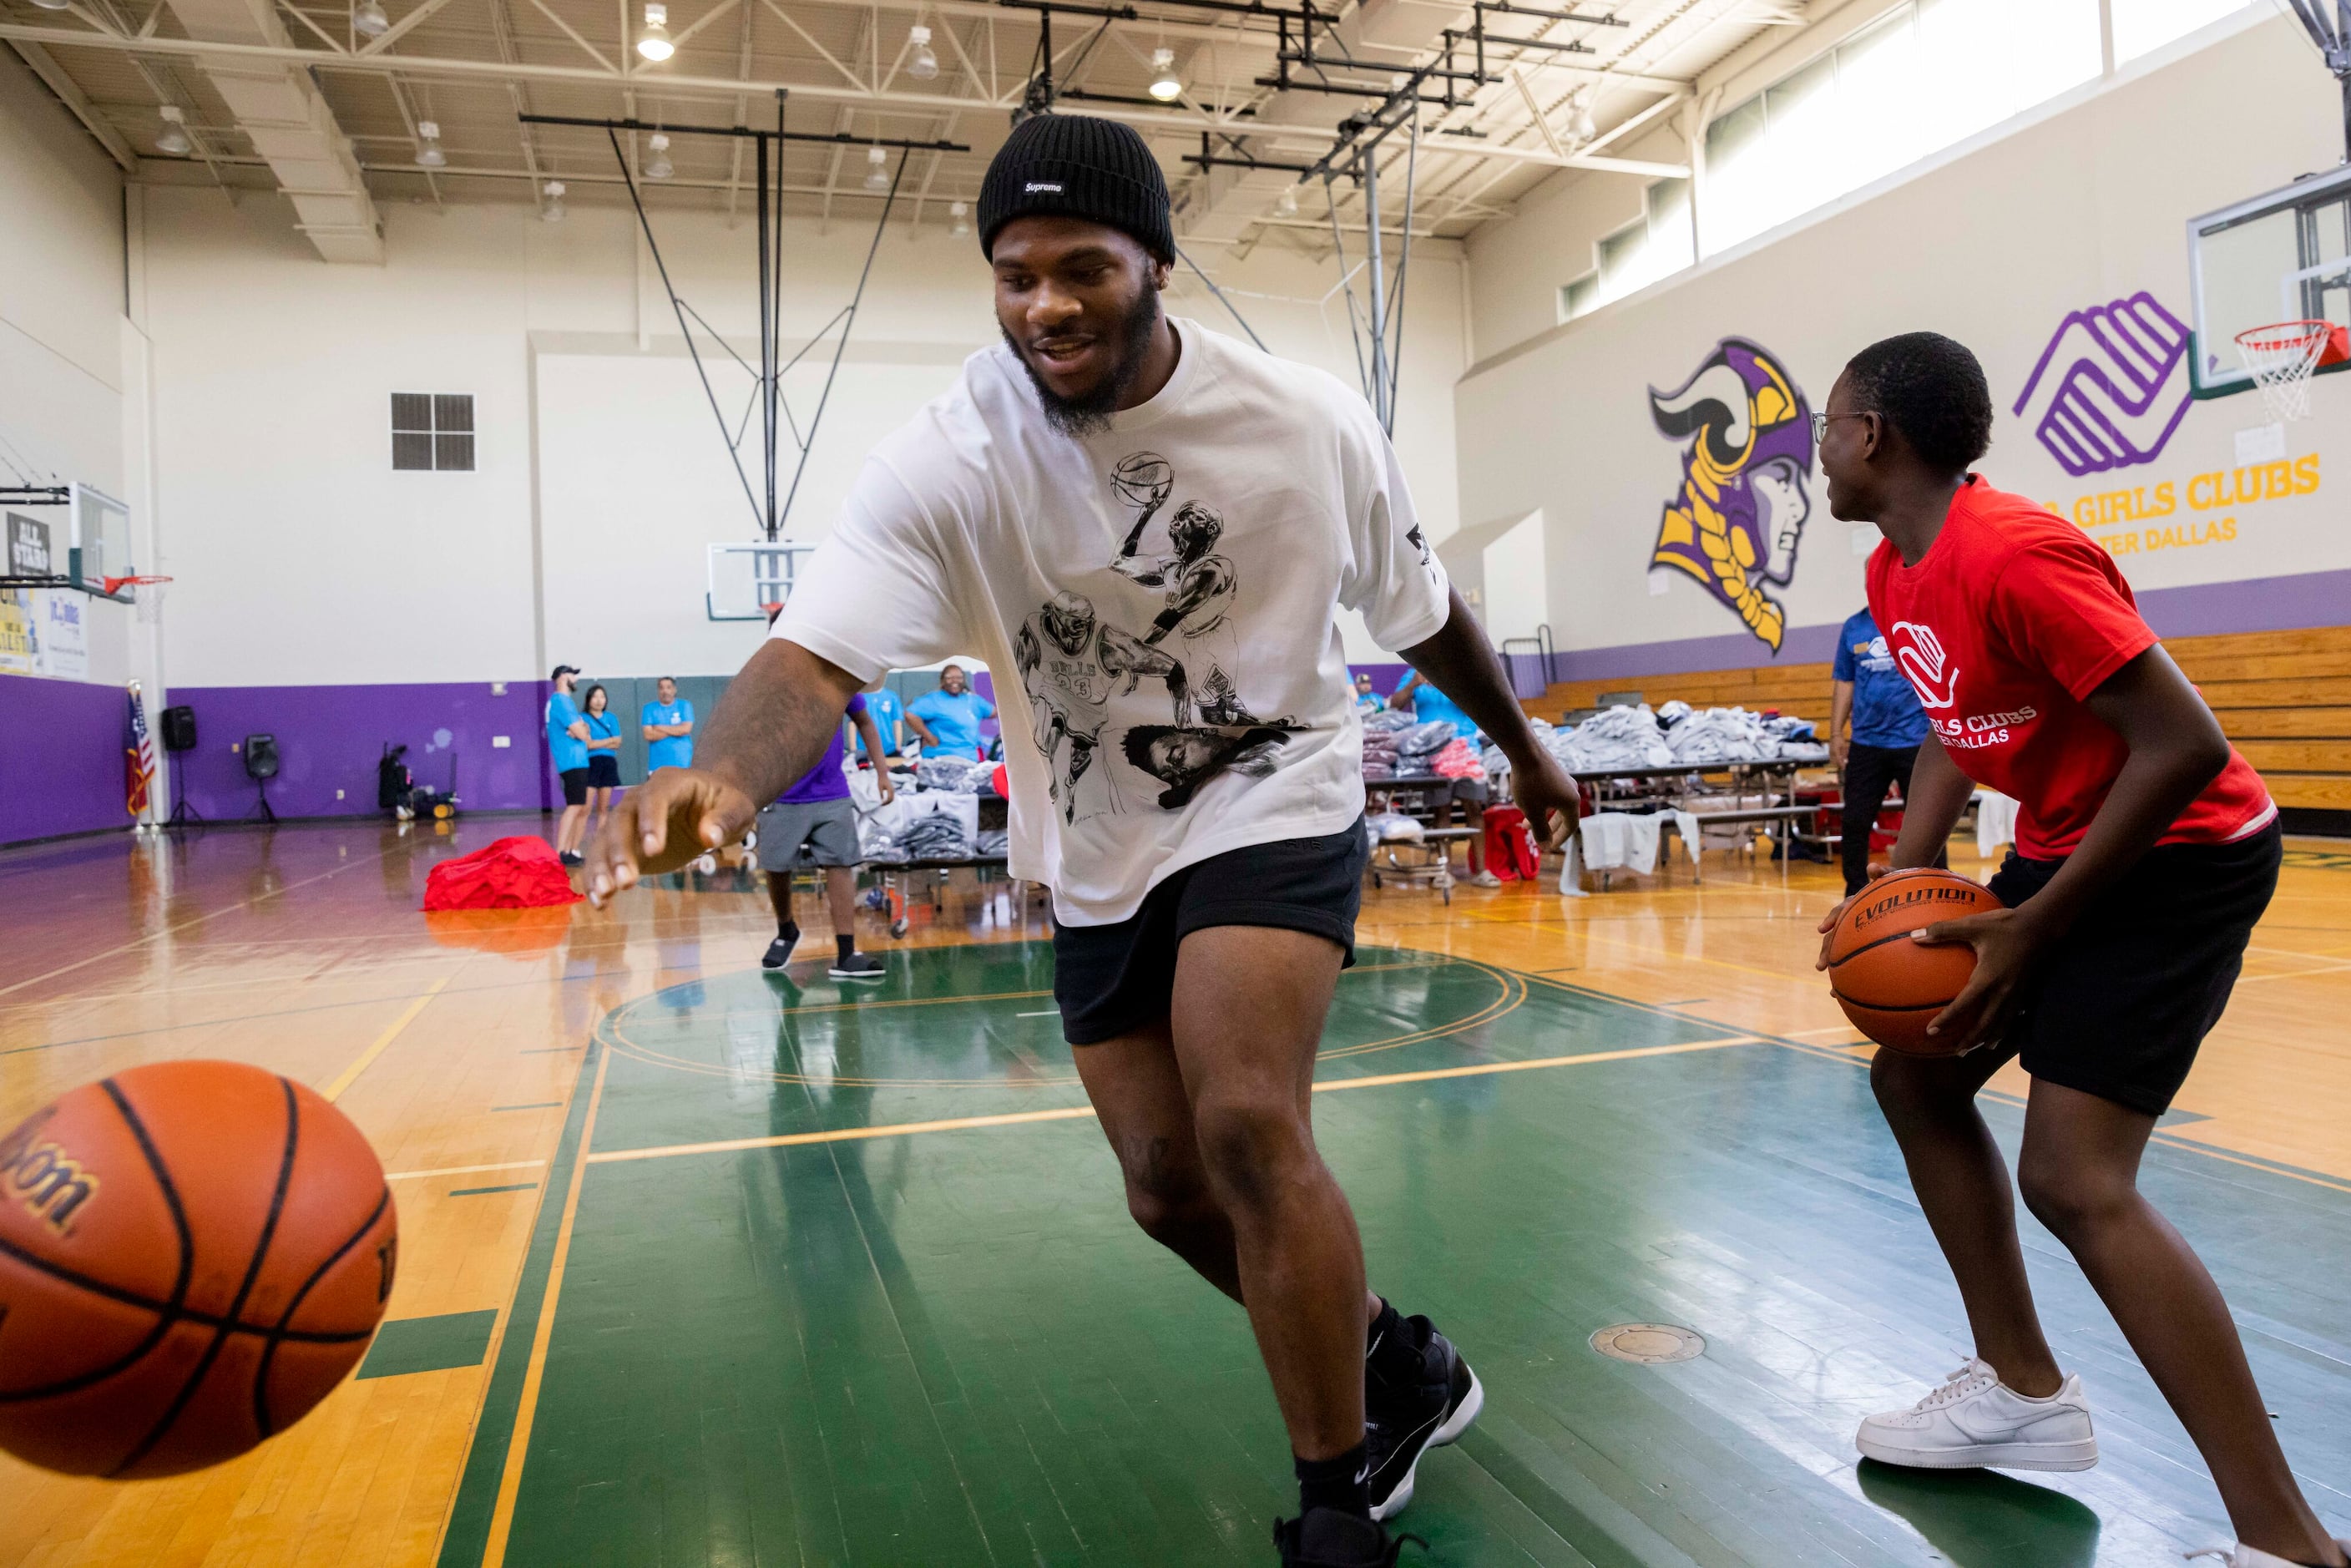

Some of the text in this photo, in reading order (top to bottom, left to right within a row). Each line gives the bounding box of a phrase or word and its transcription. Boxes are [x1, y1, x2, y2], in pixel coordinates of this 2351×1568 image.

[1025, 183, 1062, 193] Supreme
[2073, 453, 2321, 529] GIRLS CLUBS
[2146, 517, 2237, 551] DALLAS
[1966, 706, 2037, 733] CLUBS
[1952, 729, 2010, 749] DALLAS
[1855, 888, 1975, 928] EVOLUTION
